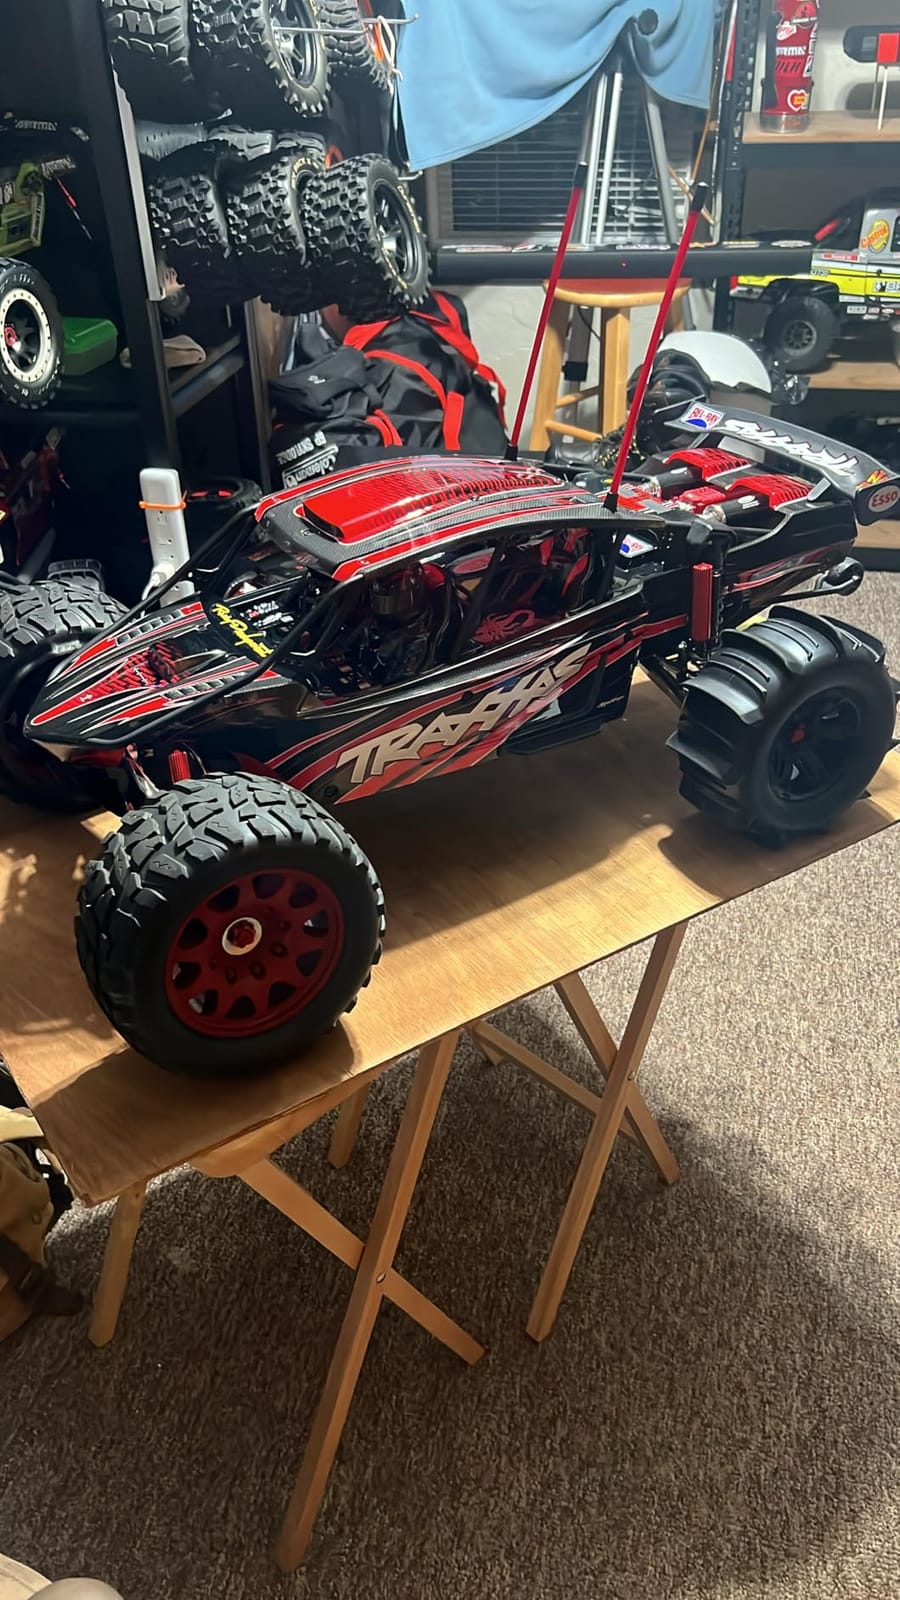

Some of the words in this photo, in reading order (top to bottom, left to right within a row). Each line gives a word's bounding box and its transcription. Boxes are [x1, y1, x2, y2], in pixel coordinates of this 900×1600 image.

[689, 406, 720, 425] BEL-RAY
[295, 455, 337, 482] Coleman
[871, 490, 898, 508] ESSO
[335, 642, 593, 784] TRAXXAS
